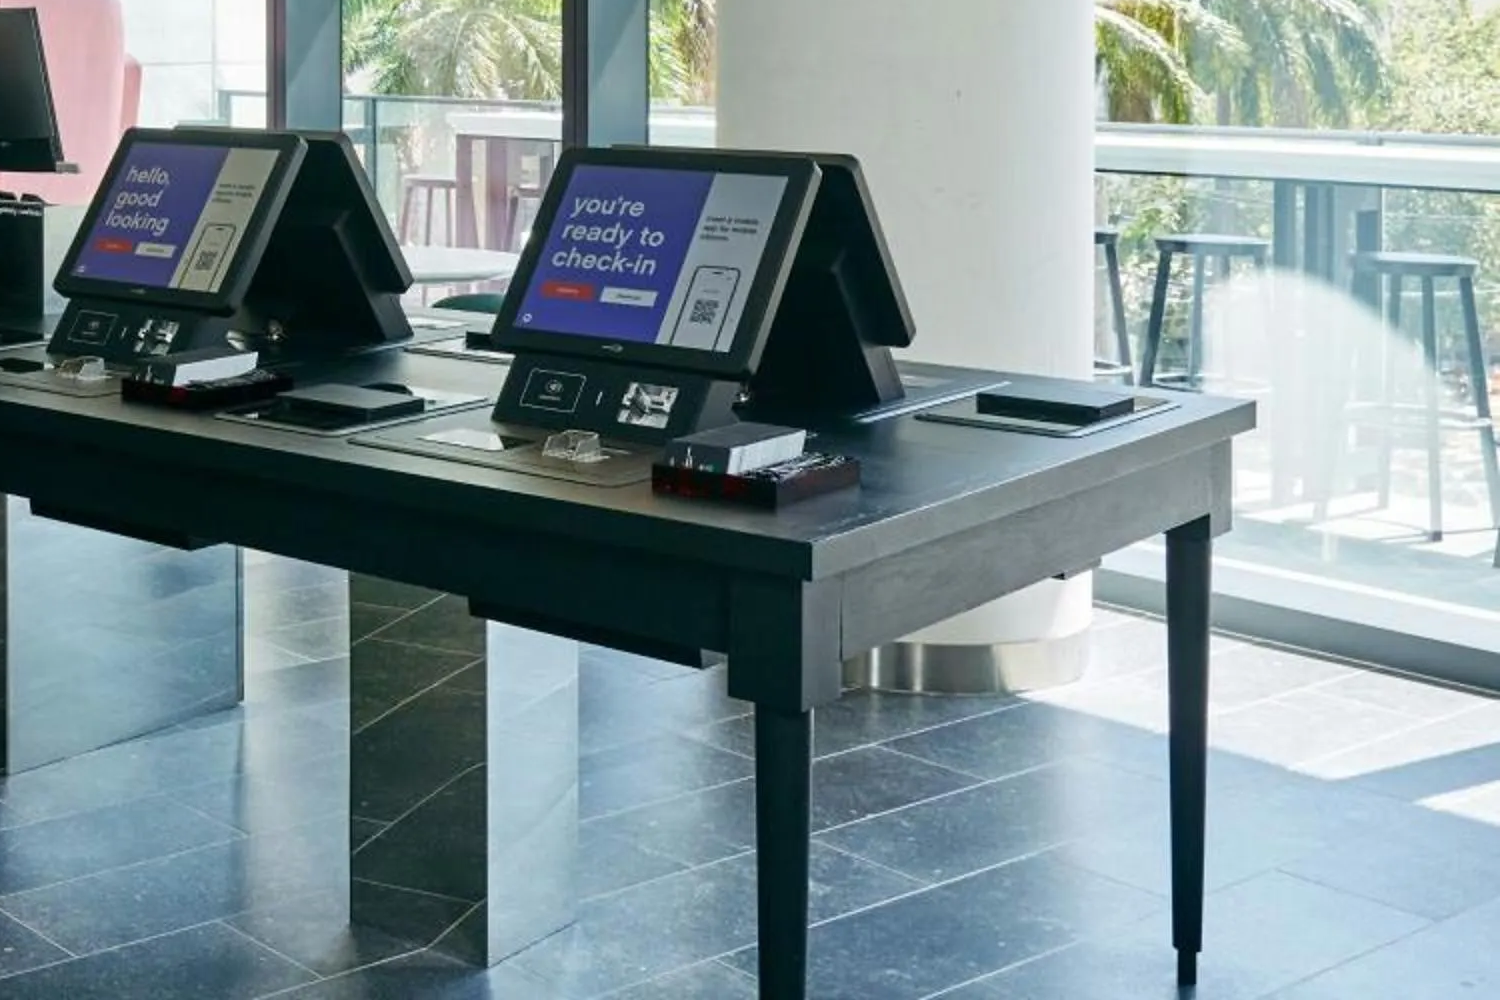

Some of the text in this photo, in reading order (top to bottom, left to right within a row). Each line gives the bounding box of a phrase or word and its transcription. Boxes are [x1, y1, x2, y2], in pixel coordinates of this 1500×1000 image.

[114, 189, 164, 209] good
[570, 195, 645, 218] you're
[105, 209, 170, 237] looking
[561, 221, 665, 249] ready to
[551, 246, 656, 275] check-in
